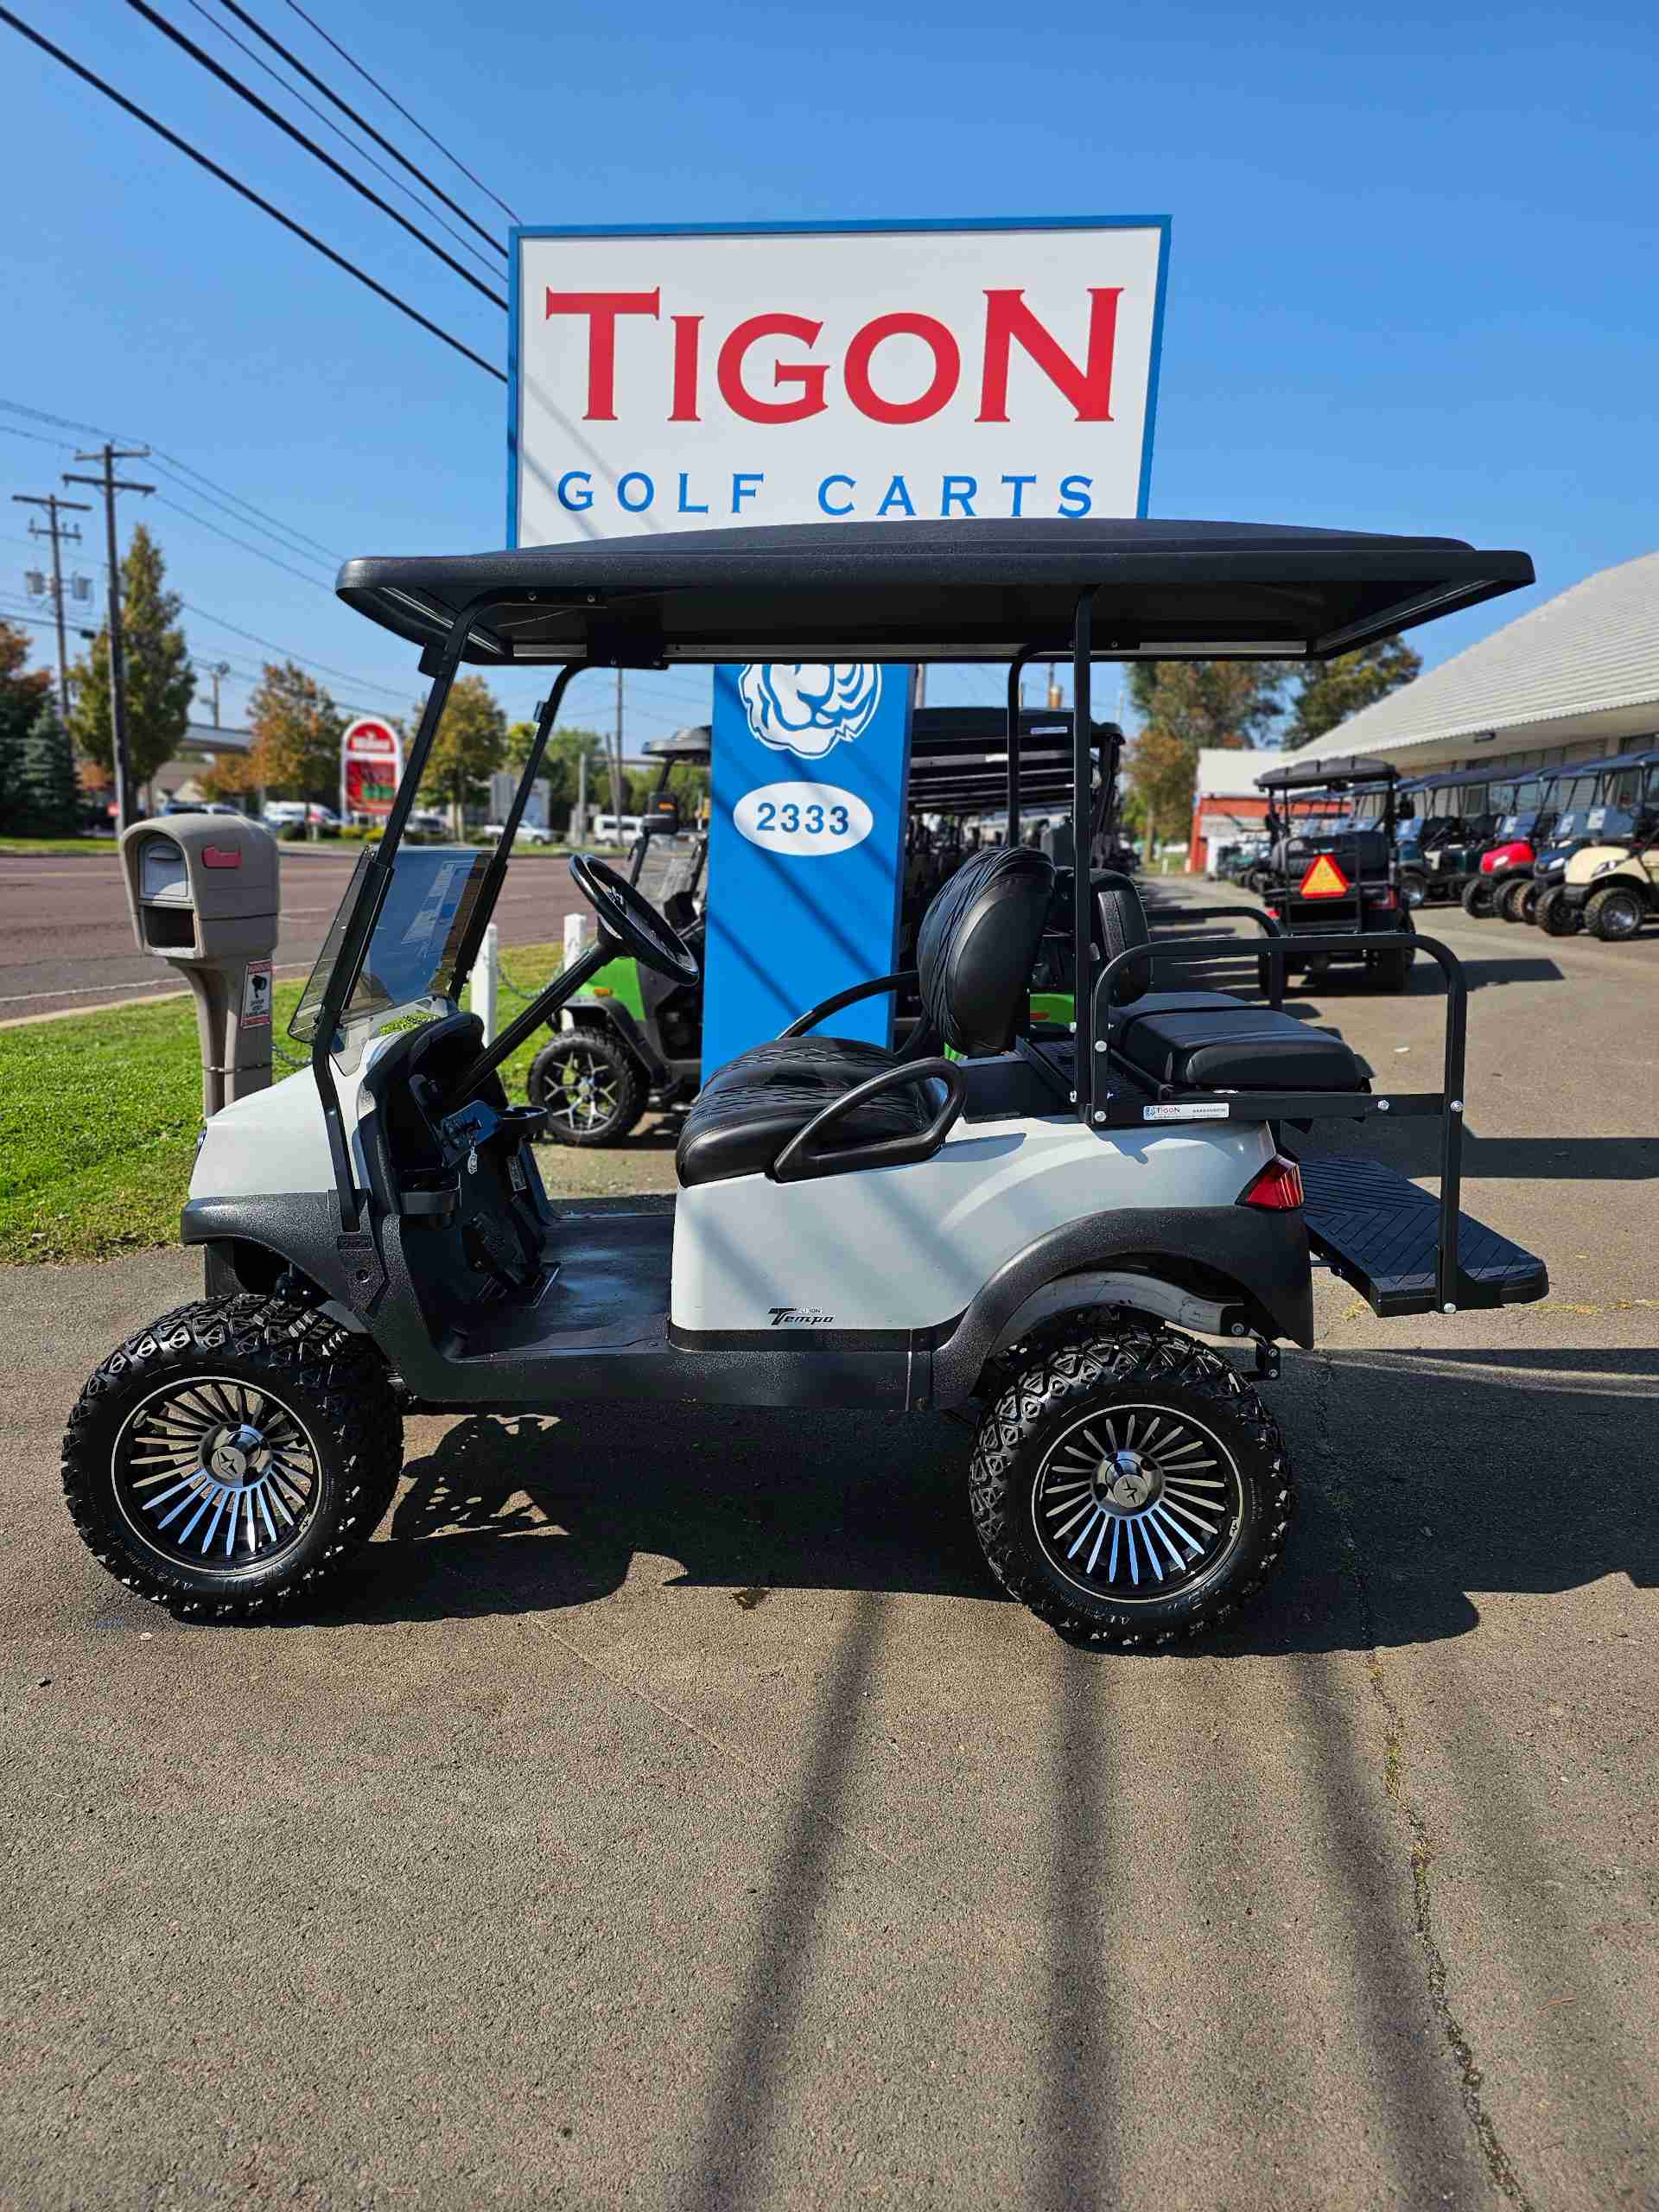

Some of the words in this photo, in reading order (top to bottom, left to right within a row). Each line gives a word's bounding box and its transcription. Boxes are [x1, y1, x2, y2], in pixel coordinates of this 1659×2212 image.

[545, 286, 1125, 424] TIGON
[557, 471, 764, 513] GOLF
[817, 474, 1093, 518] CARTS
[756, 803, 849, 836] 2333
[767, 1307, 834, 1325] Tempo
